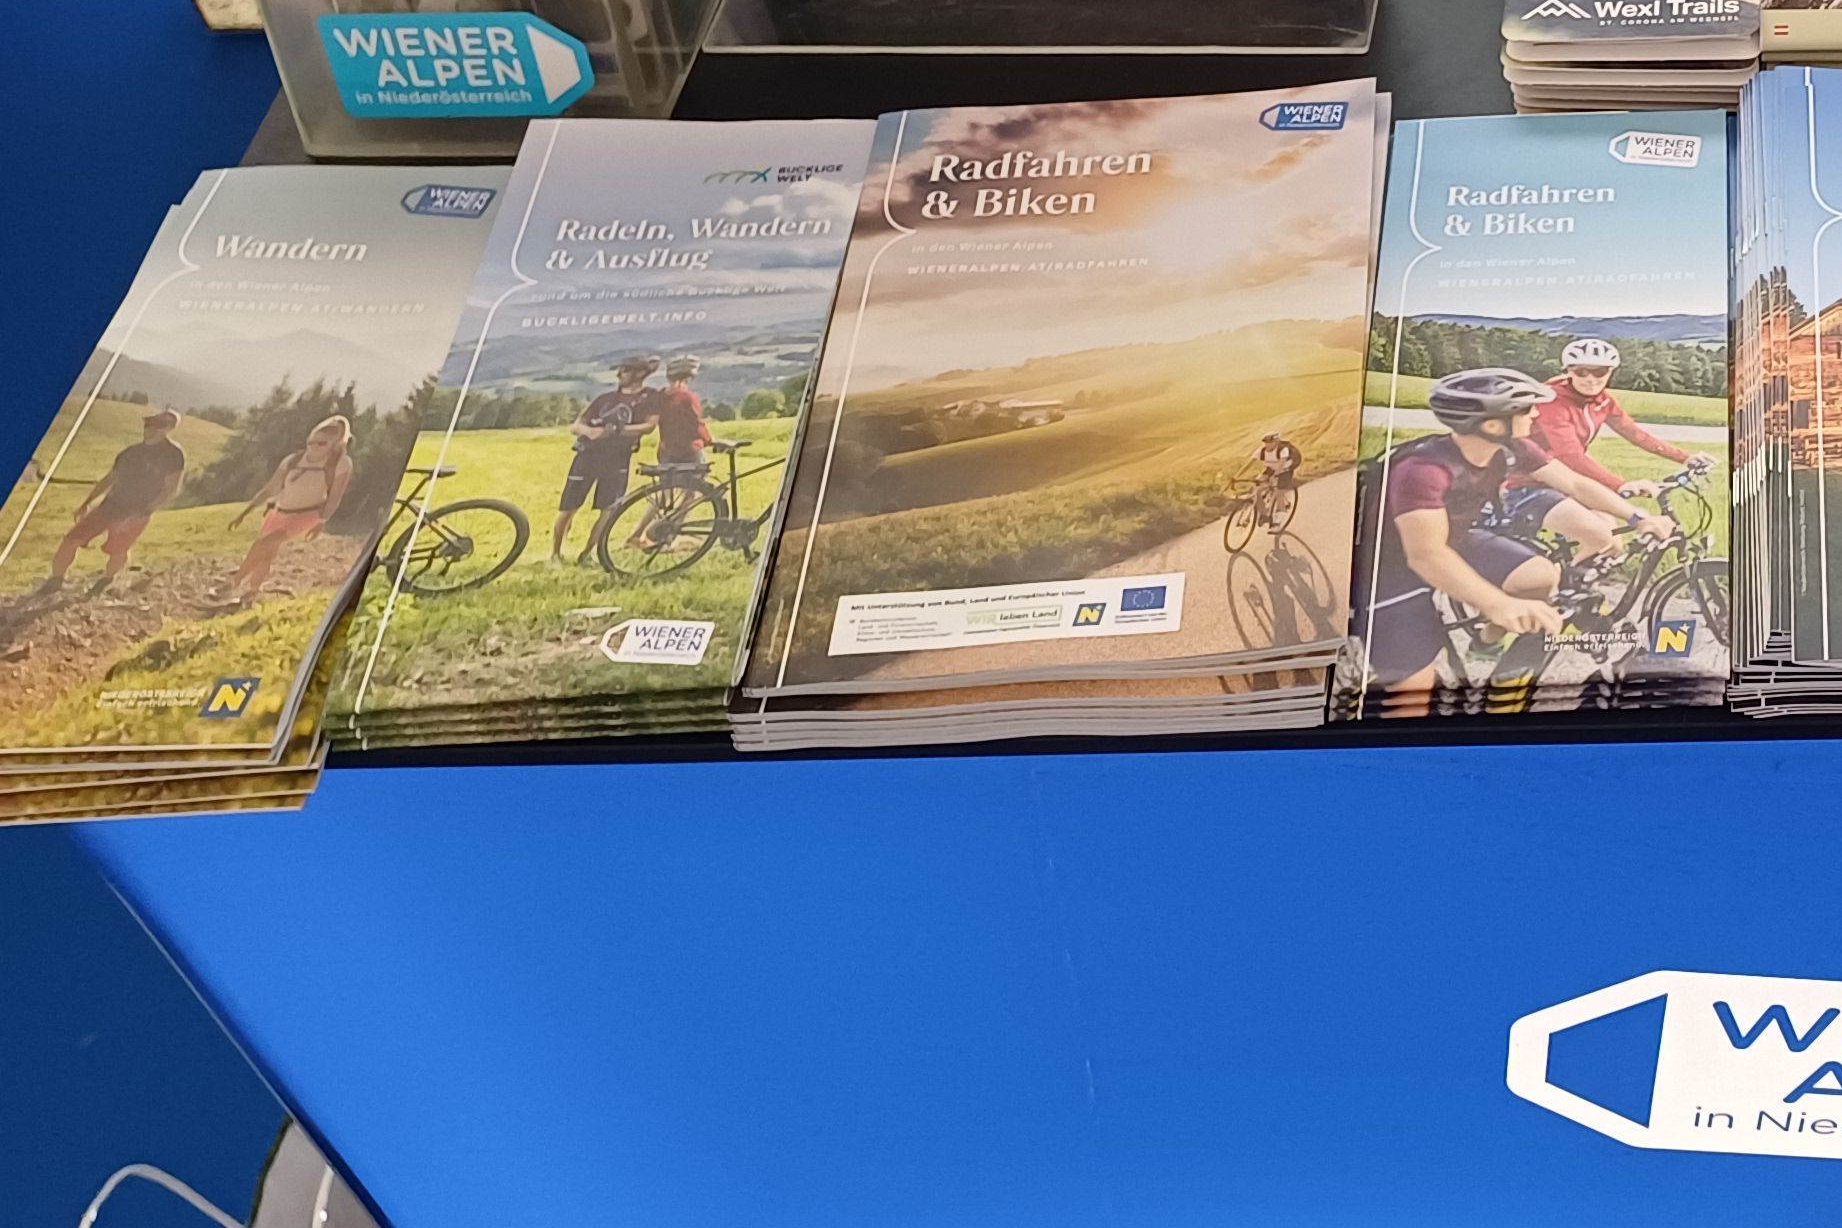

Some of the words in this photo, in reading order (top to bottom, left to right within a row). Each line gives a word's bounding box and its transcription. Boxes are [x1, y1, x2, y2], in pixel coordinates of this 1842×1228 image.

[1594, 0, 1660, 18] Wexl
[333, 27, 518, 57] WIENER
[378, 58, 526, 88] ALPEN
[355, 91, 373, 104] in
[378, 90, 533, 104] Niederösterreich
[1284, 103, 1343, 116] WIENER
[1291, 113, 1341, 124] ALPEN
[1634, 136, 1696, 150] WIENER
[1642, 146, 1695, 158] ALPEN
[778, 164, 843, 174] BUCKLIGE
[930, 151, 1152, 183] Radfahren
[777, 174, 812, 183] WELT
[430, 188, 490, 201] WIENER
[1447, 186, 1616, 207] Radfahren
[433, 199, 487, 212] ALPEN
[922, 191, 958, 219] &
[974, 189, 1095, 217] Biken
[556, 220, 675, 241] Radeln,
[690, 216, 832, 239] Wandern
[1444, 215, 1470, 236] &
[1483, 213, 1575, 235] Biken
[215, 235, 367, 262] Wandern
[545, 249, 572, 270] &
[584, 247, 713, 272] Ausflug
[635, 625, 707, 639] WIENER
[639, 638, 701, 652] ALPEN
[1693, 1106, 1734, 1129] in
